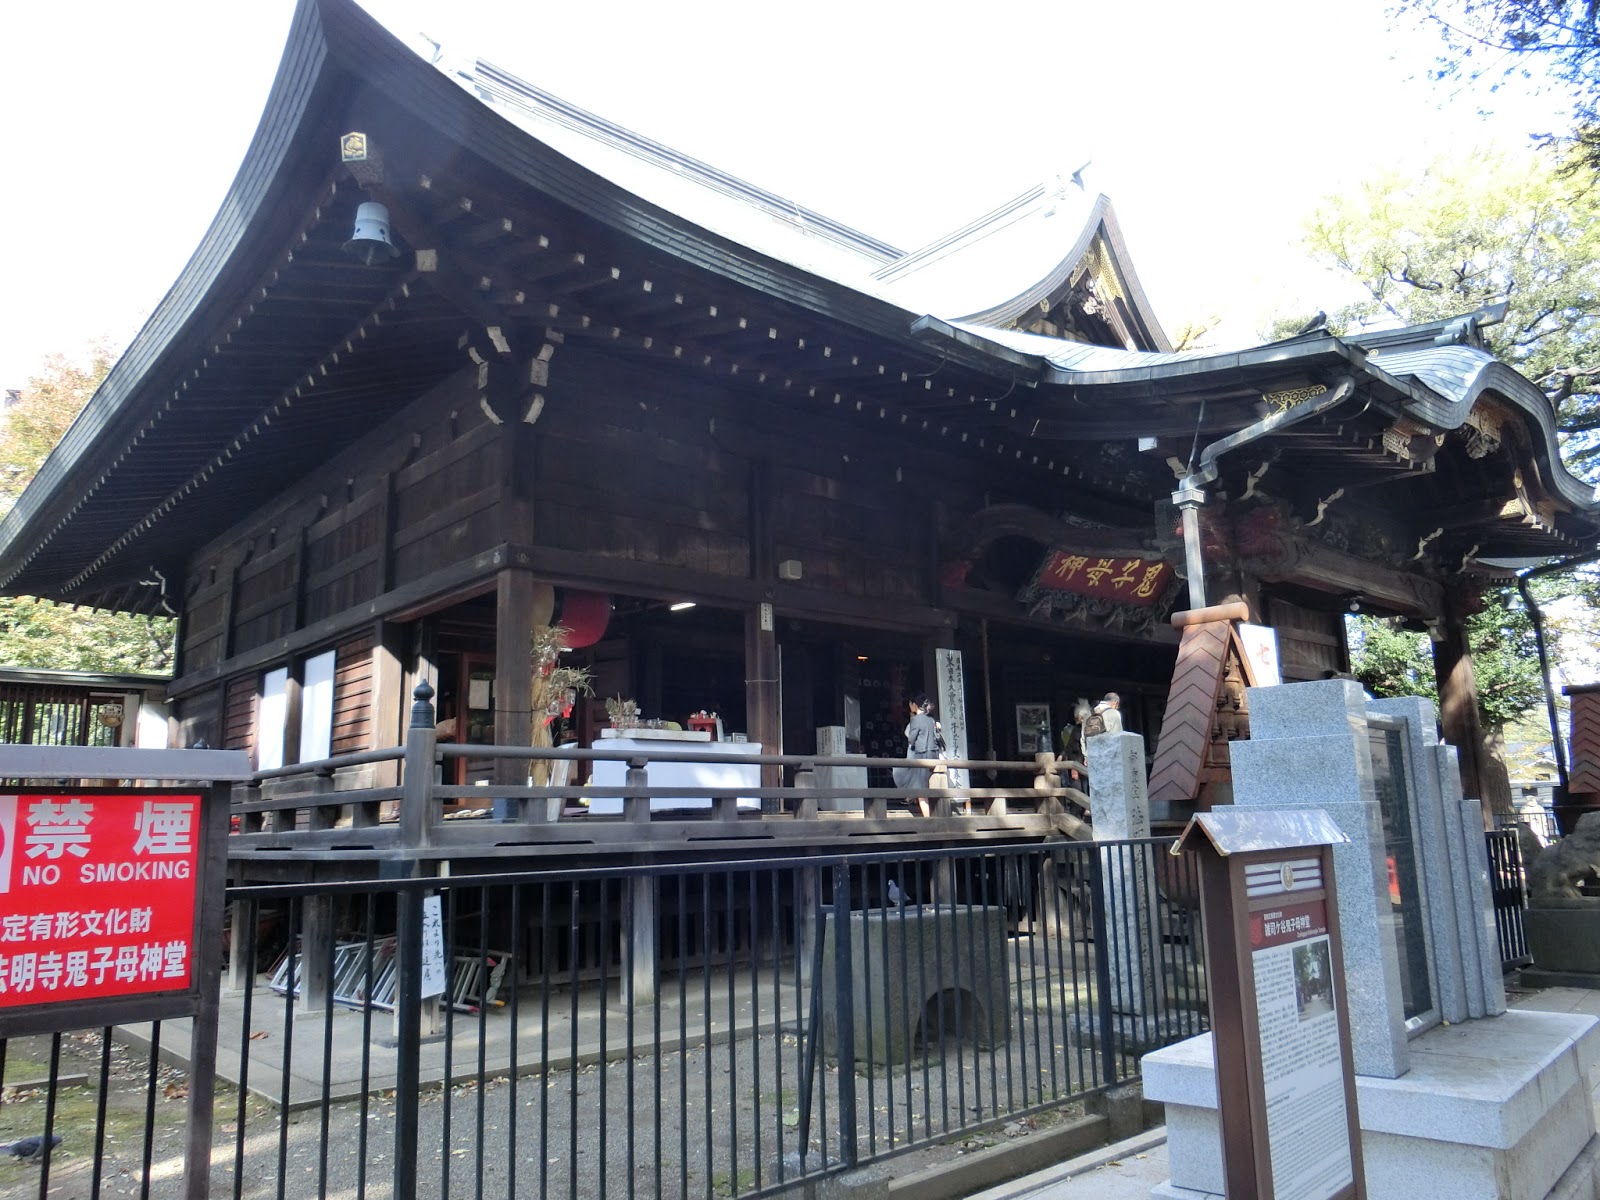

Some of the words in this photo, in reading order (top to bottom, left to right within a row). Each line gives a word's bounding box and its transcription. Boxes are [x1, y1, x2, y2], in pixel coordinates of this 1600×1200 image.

[25, 798, 193, 859] 禁煙
[22, 864, 61, 886] NO
[80, 860, 190, 883] SMOKING
